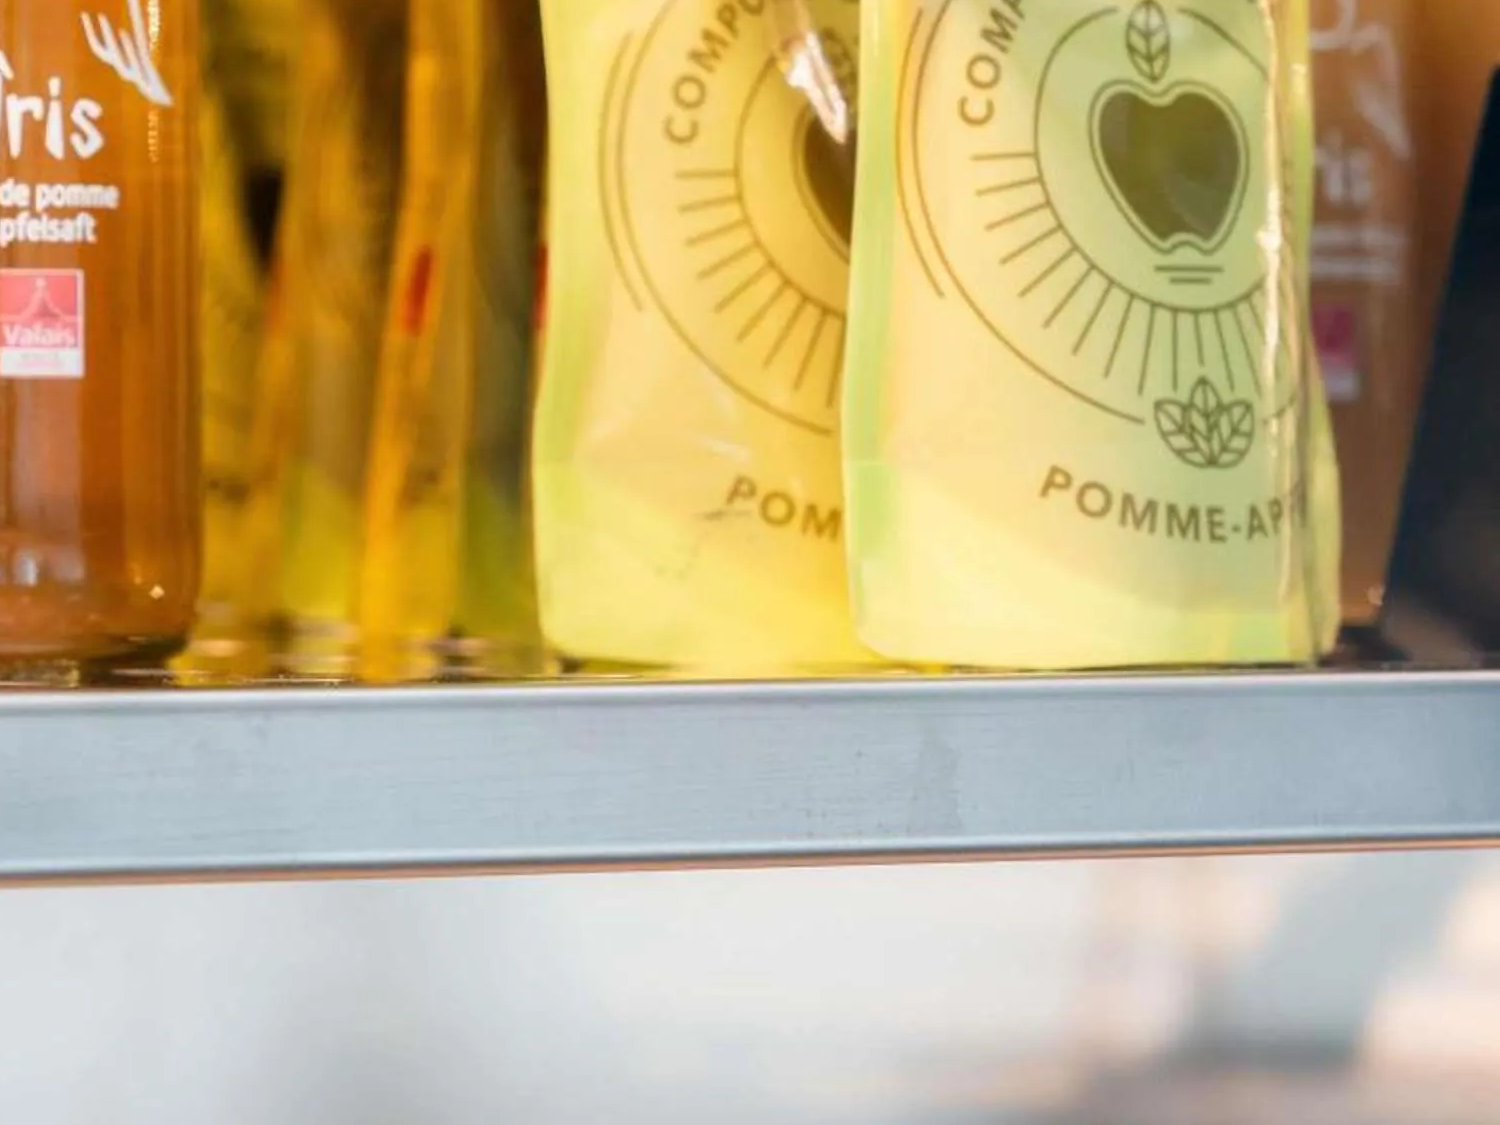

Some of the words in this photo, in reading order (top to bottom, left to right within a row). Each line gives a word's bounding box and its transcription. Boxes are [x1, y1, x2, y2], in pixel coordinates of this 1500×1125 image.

[35, 182, 121, 213] pomme
[3, 323, 75, 347] Valais
[726, 475, 842, 543] POM
[1039, 464, 1286, 543] POMME-AP
